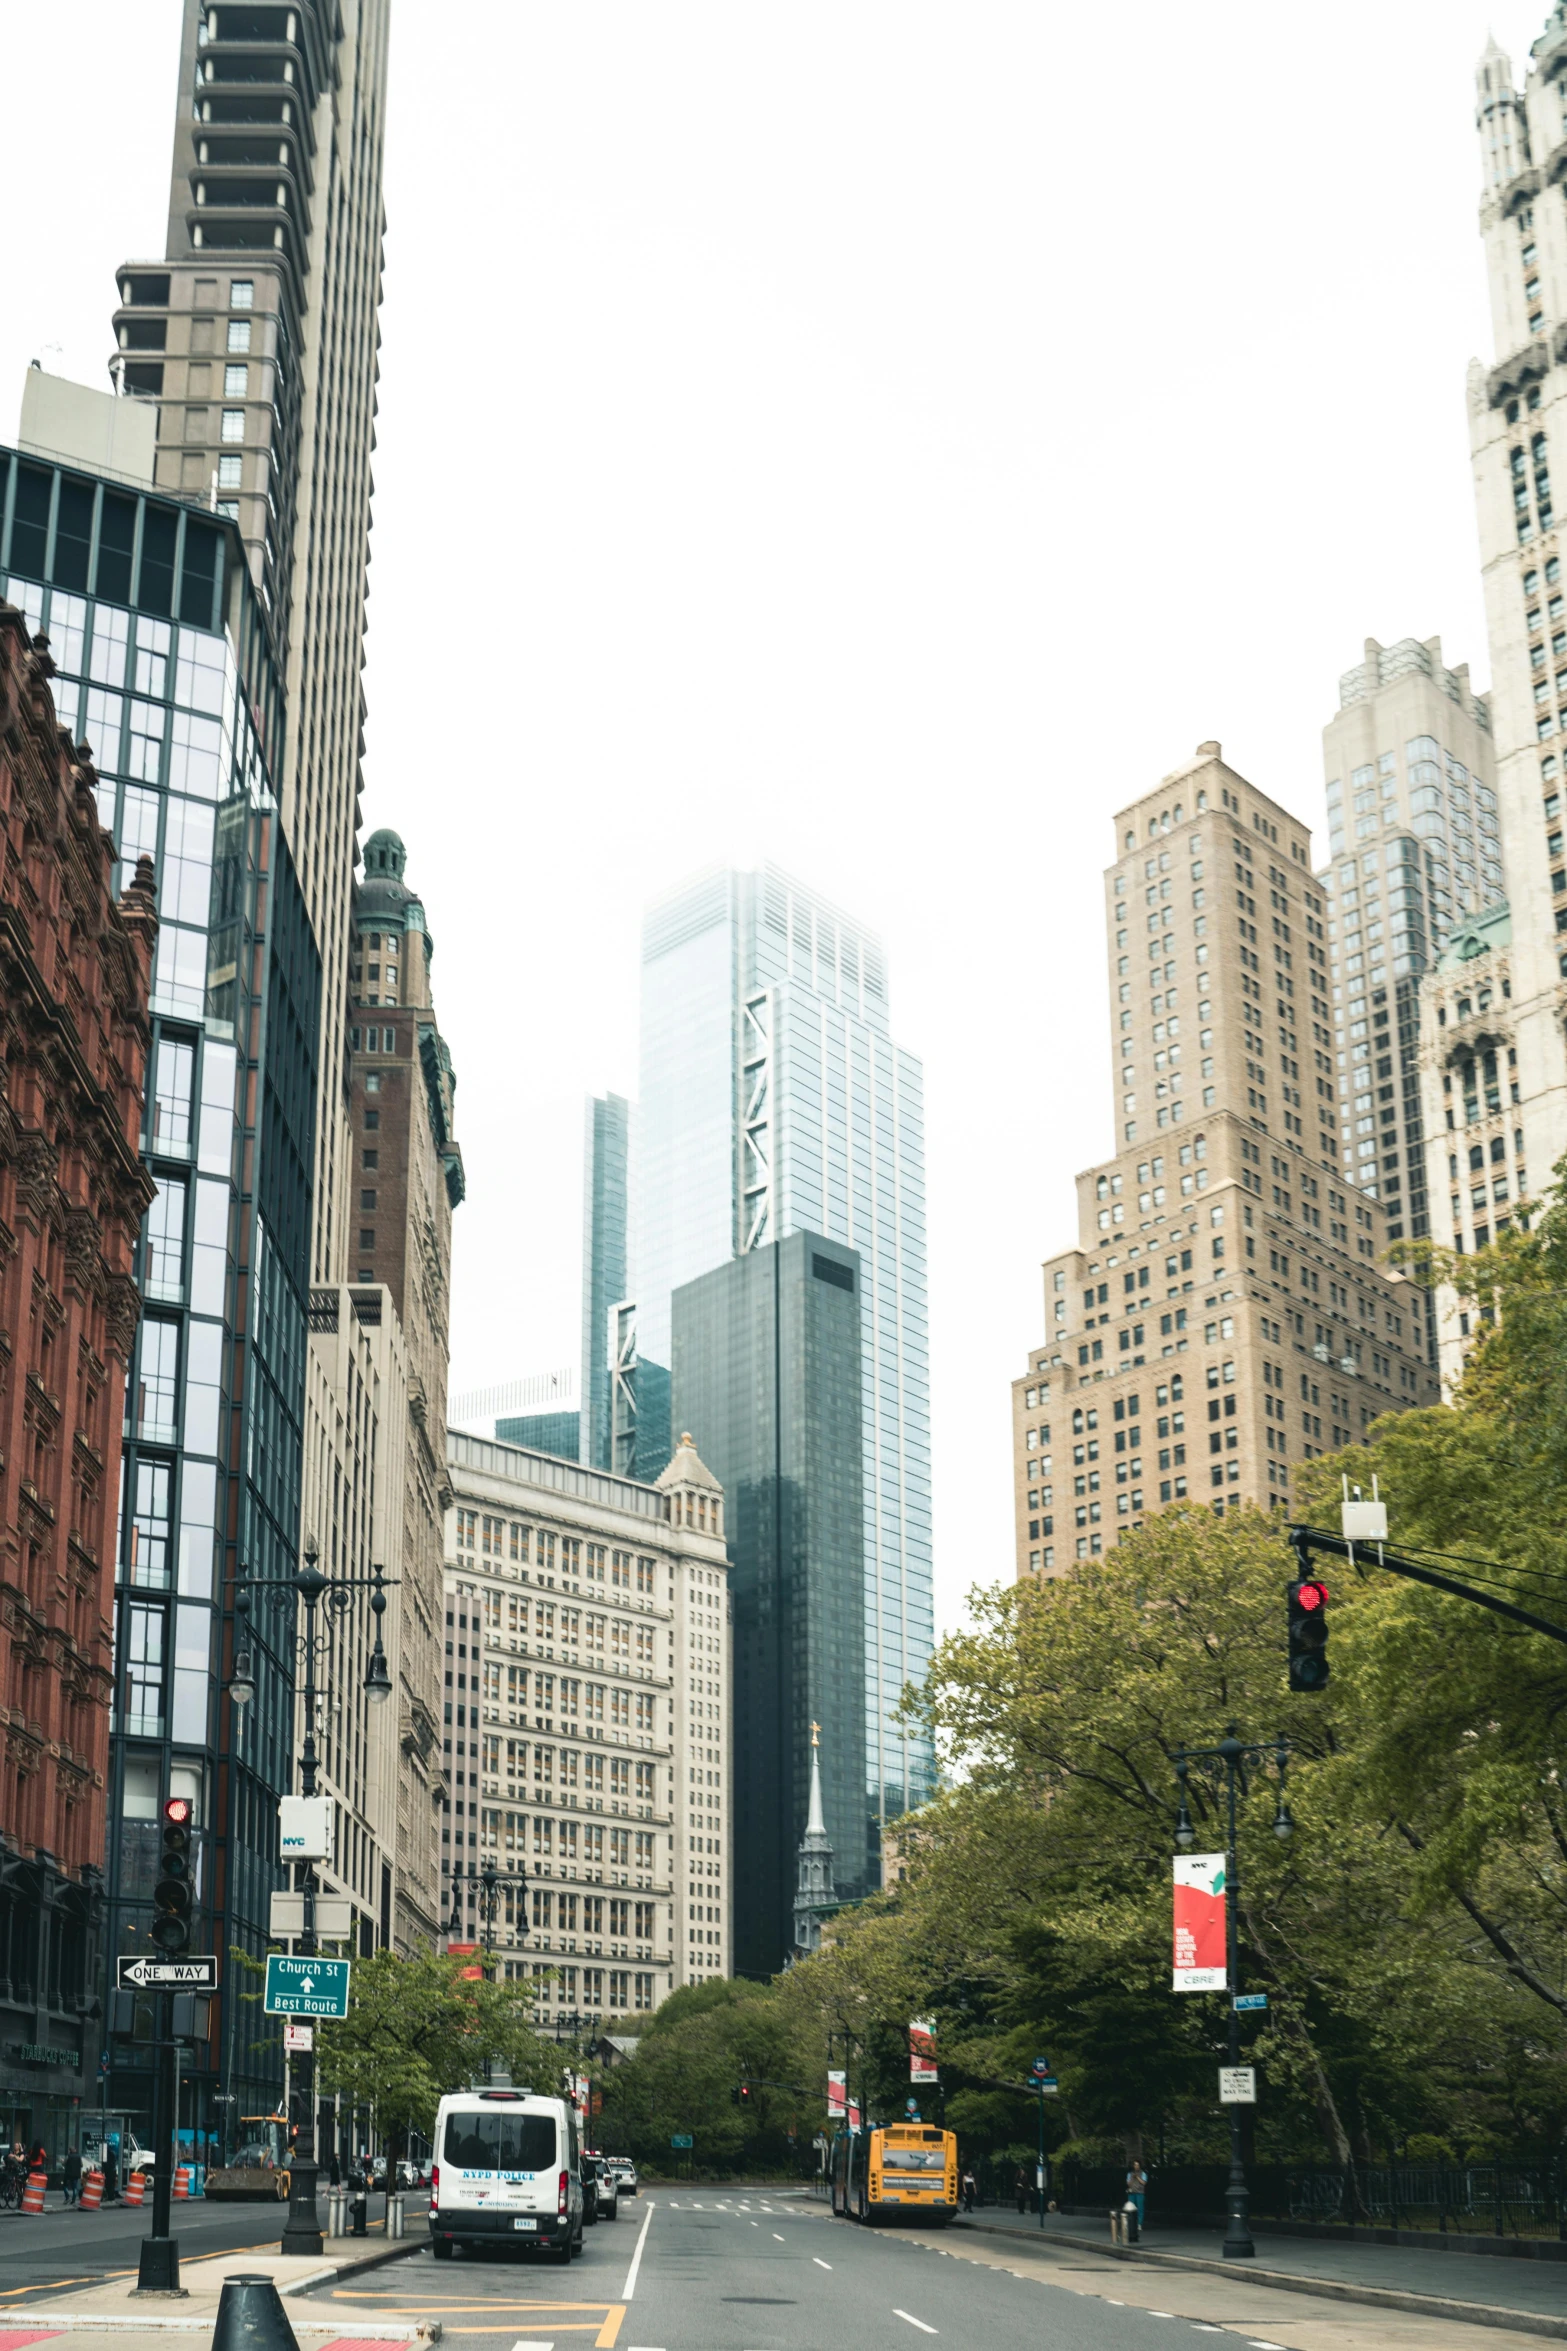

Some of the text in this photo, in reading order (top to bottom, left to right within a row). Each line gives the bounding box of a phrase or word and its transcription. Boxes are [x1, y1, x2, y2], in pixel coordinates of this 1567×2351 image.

[283, 1837, 305, 1846] NYC
[134, 1967, 203, 1979] ONE WAY
[278, 1960, 339, 1977] Church St
[1184, 1975, 1216, 1985] CBRE
[274, 1996, 338, 2013] Best Route
[21, 2043, 79, 2067] STARBUCKS COFFEE
[463, 2170, 536, 2181] NYPD POLICE
